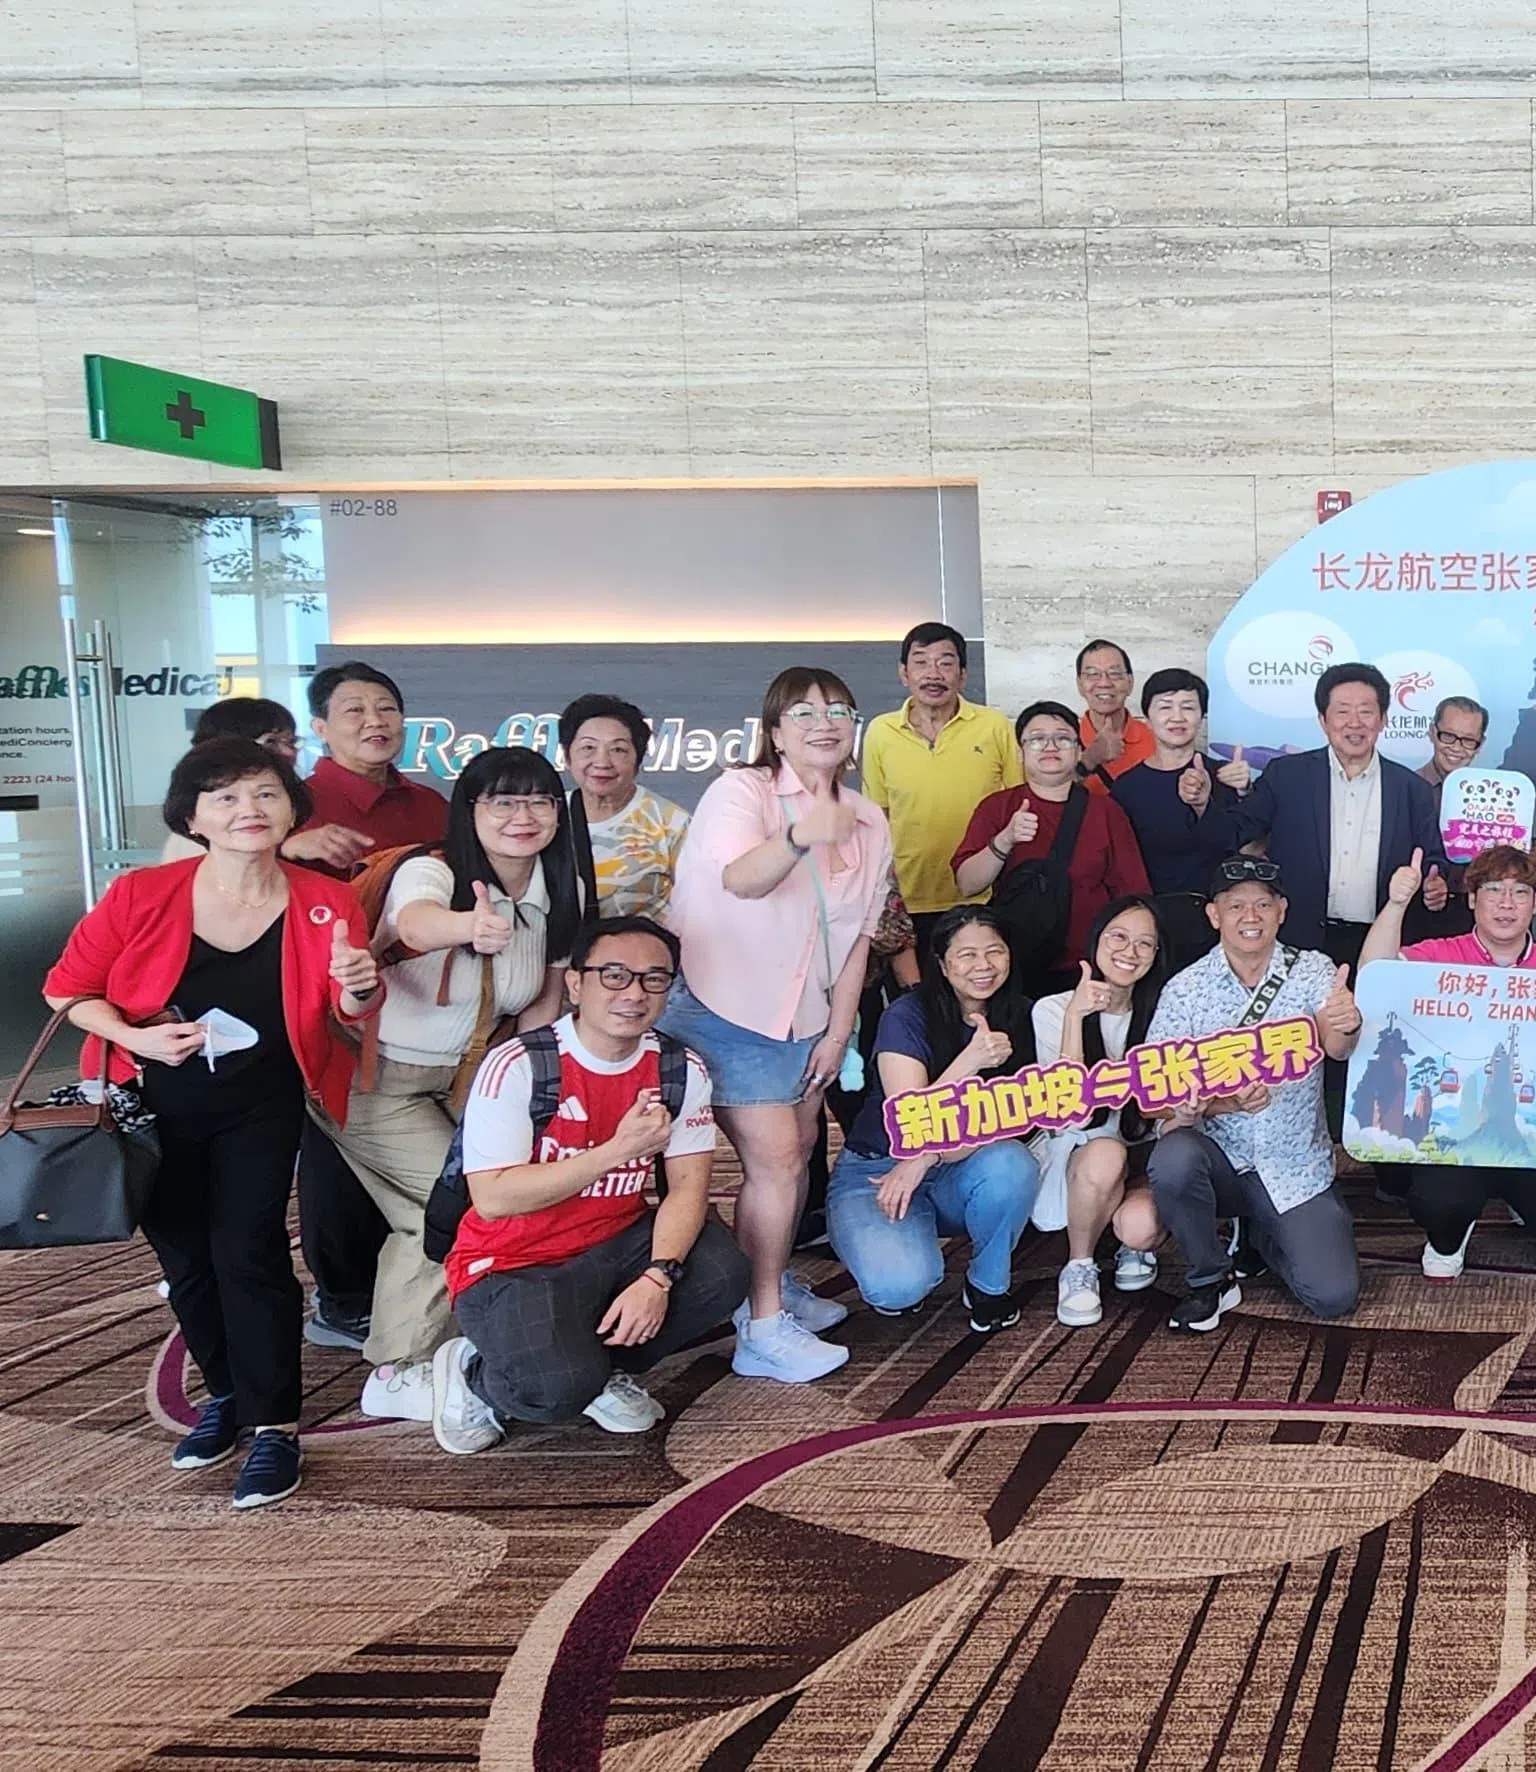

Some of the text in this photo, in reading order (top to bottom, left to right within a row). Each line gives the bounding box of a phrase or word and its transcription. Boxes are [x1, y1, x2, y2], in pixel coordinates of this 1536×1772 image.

[329, 499, 397, 516] #02-88
[1248, 661, 1329, 676] CHANG
[0, 738, 72, 747] ediConcierg
[398, 713, 568, 780] Raffl
[4, 776, 31, 784] 2223
[1466, 811, 1495, 821] HAO
[1413, 1000, 1473, 1022] HELLO,
